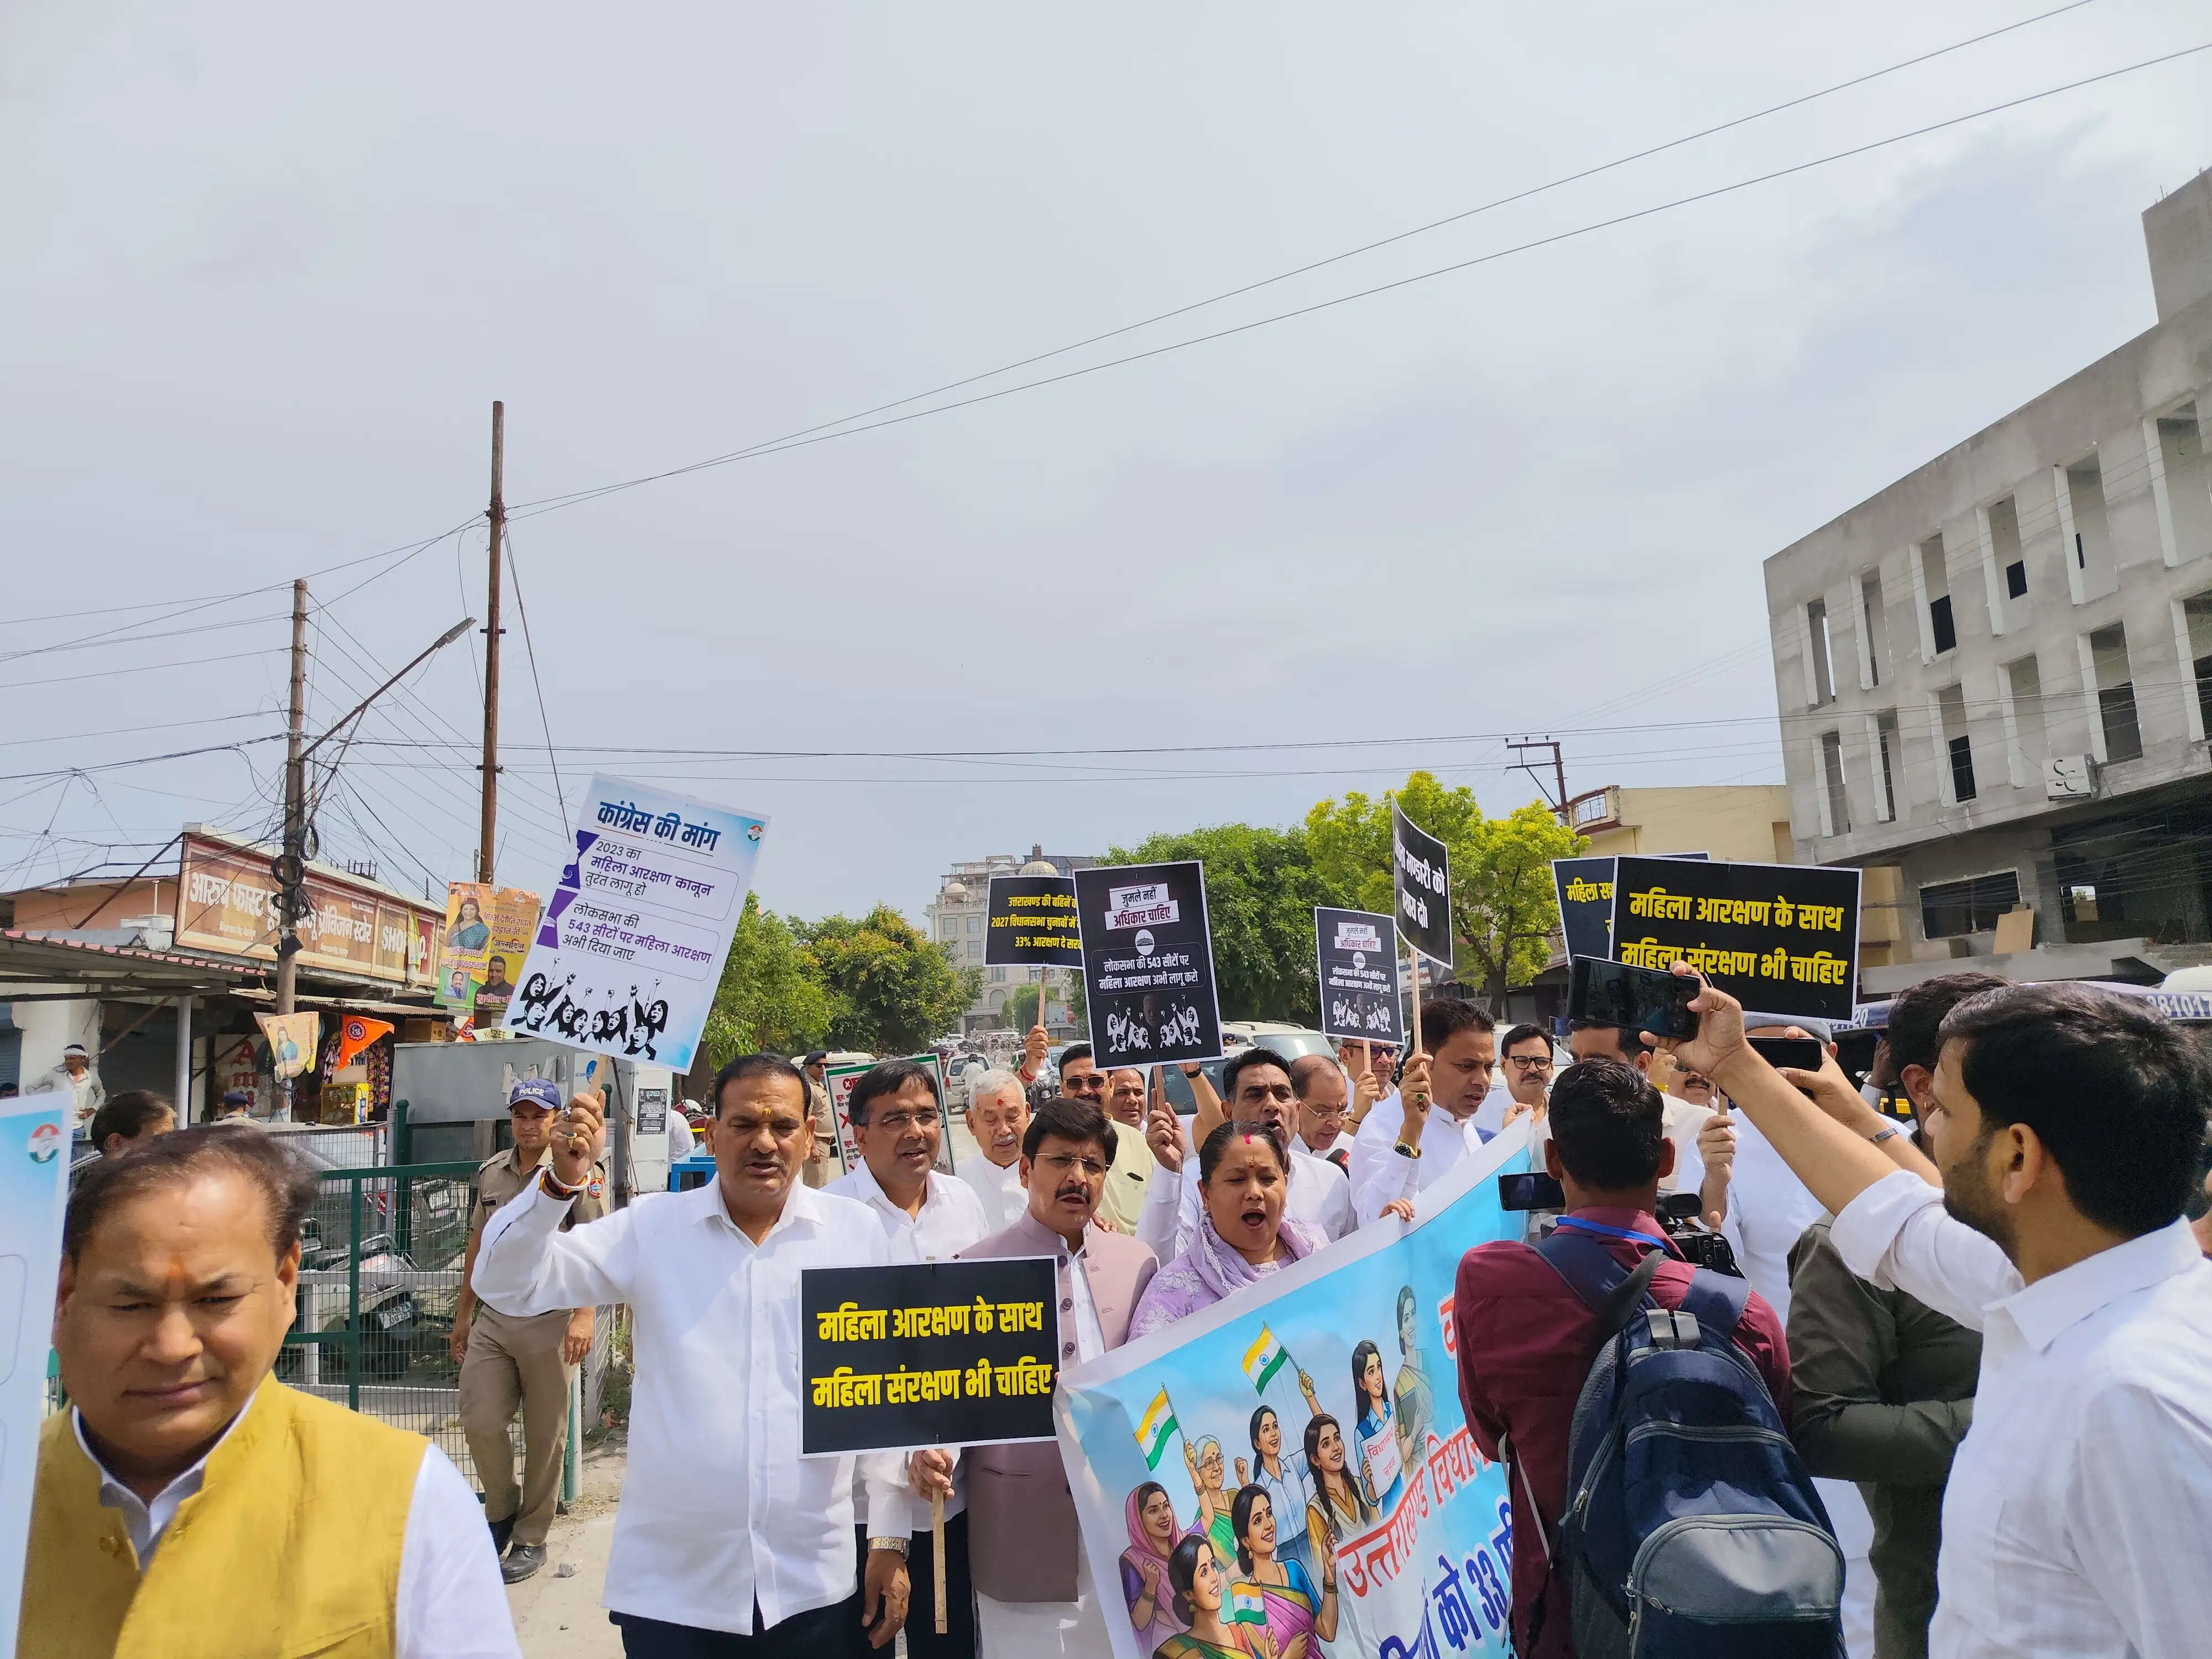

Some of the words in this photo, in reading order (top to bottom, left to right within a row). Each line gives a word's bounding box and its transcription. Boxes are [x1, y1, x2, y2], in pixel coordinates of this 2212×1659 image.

[598, 800, 654, 834] कांग्रेस
[655, 812, 681, 841] की
[681, 822, 721, 851] मांग
[596, 841, 624, 857] 2023
[626, 848, 642, 860] का
[591, 855, 628, 875] महिला
[629, 865, 672, 885] आरक्षण
[1432, 867, 1445, 896] को
[586, 871, 609, 888] तुरंत
[611, 878, 634, 896] लागू
[635, 883, 647, 896] हो
[1566, 877, 1599, 902] महिला
[1008, 897, 1041, 907] उत्तराखण्ड
[1041, 894, 1051, 907] की
[1121, 890, 1141, 907] जुमले
[1144, 886, 1157, 900] नहीं
[574, 904, 622, 925] लोकसभा
[623, 914, 639, 929] की
[992, 917, 1009, 927] 2027
[1010, 914, 1046, 927] विधानसभा
[1047, 916, 1069, 930] चुनावों
[1068, 915, 1077, 928] में
[1114, 910, 1147, 927] अधिकार
[1148, 904, 1170, 921] चाहिए
[1629, 887, 1693, 921] महिला
[1695, 897, 1771, 927] आरक्षण
[1772, 896, 1796, 928] के
[1797, 904, 1844, 932] साथ
[568, 919, 590, 933] 543
[592, 922, 620, 941] सीटों
[619, 931, 634, 944] पर
[636, 935, 671, 954] महिला
[672, 945, 712, 964] आरक्षण
[1015, 937, 1031, 947] 33%
[1033, 937, 1060, 948] आरक्षण
[1061, 935, 1066, 948] दे
[1340, 938, 1360, 948] अधिकार
[1362, 938, 1376, 949] चाहिए
[1346, 927, 1358, 936] जुमले
[562, 933, 588, 952] अभी
[588, 940, 612, 956] दिया
[613, 948, 635, 961] जाए
[1104, 958, 1135, 972] लोकसभा
[1136, 957, 1146, 969] की
[1147, 957, 1161, 969] 543
[1161, 953, 1178, 967] सीटों
[1179, 954, 1190, 966] पर
[1332, 966, 1353, 977] लोकसभा
[1353, 968, 1359, 977] की
[1360, 969, 1369, 978] 543
[1621, 937, 1684, 971] महिला
[1686, 943, 1756, 978] संरक्षण
[1761, 948, 1788, 980] भी
[1790, 949, 1848, 985] चाहिए
[1098, 975, 1123, 990] महिला
[1124, 976, 1151, 988] आरक्षण
[1152, 973, 1168, 985] अभी
[1169, 972, 1185, 987] लागू
[1186, 969, 1198, 983] करो
[1328, 977, 1344, 987] महिला
[1345, 979, 1362, 989] आरक्षण
[519, 1087, 545, 1097] POLICE
[817, 1302, 888, 1342] महिला
[892, 1305, 971, 1337] आरक्षण
[973, 1296, 995, 1333] के
[997, 1302, 1043, 1332] साथ
[811, 1366, 882, 1407] महिला
[885, 1364, 961, 1403] संरक्षण
[966, 1358, 994, 1398] भी
[995, 1356, 1052, 1396] चाहिए
[1337, 1466, 1429, 1598] उत्तराखण्ड
[1432, 1554, 1481, 1651] को
[1465, 1550, 1507, 1631] 33
